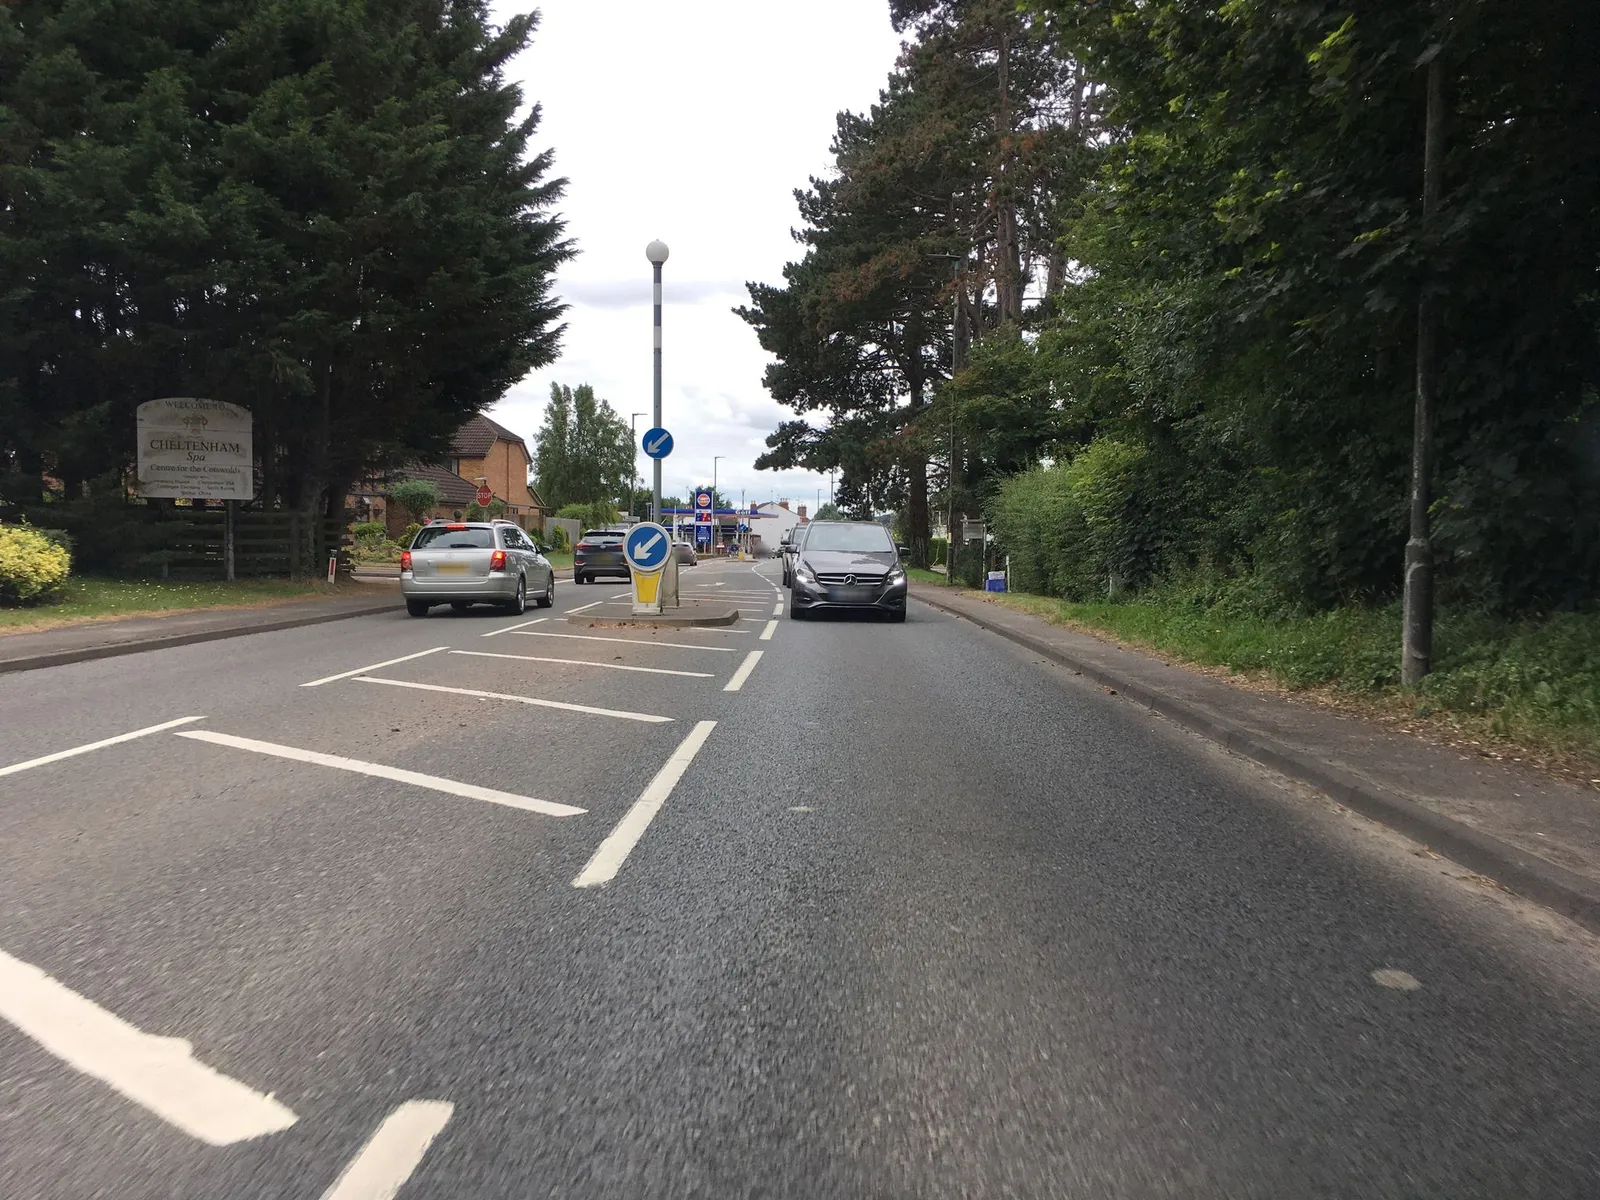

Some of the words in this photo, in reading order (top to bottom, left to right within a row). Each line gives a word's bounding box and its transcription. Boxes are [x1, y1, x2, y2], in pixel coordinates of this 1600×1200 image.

[150, 439, 240, 453] CHELTENHAM
[186, 451, 206, 463] Spa
[150, 463, 175, 472] Centre
[177, 464, 188, 472] for
[190, 465, 202, 473] the
